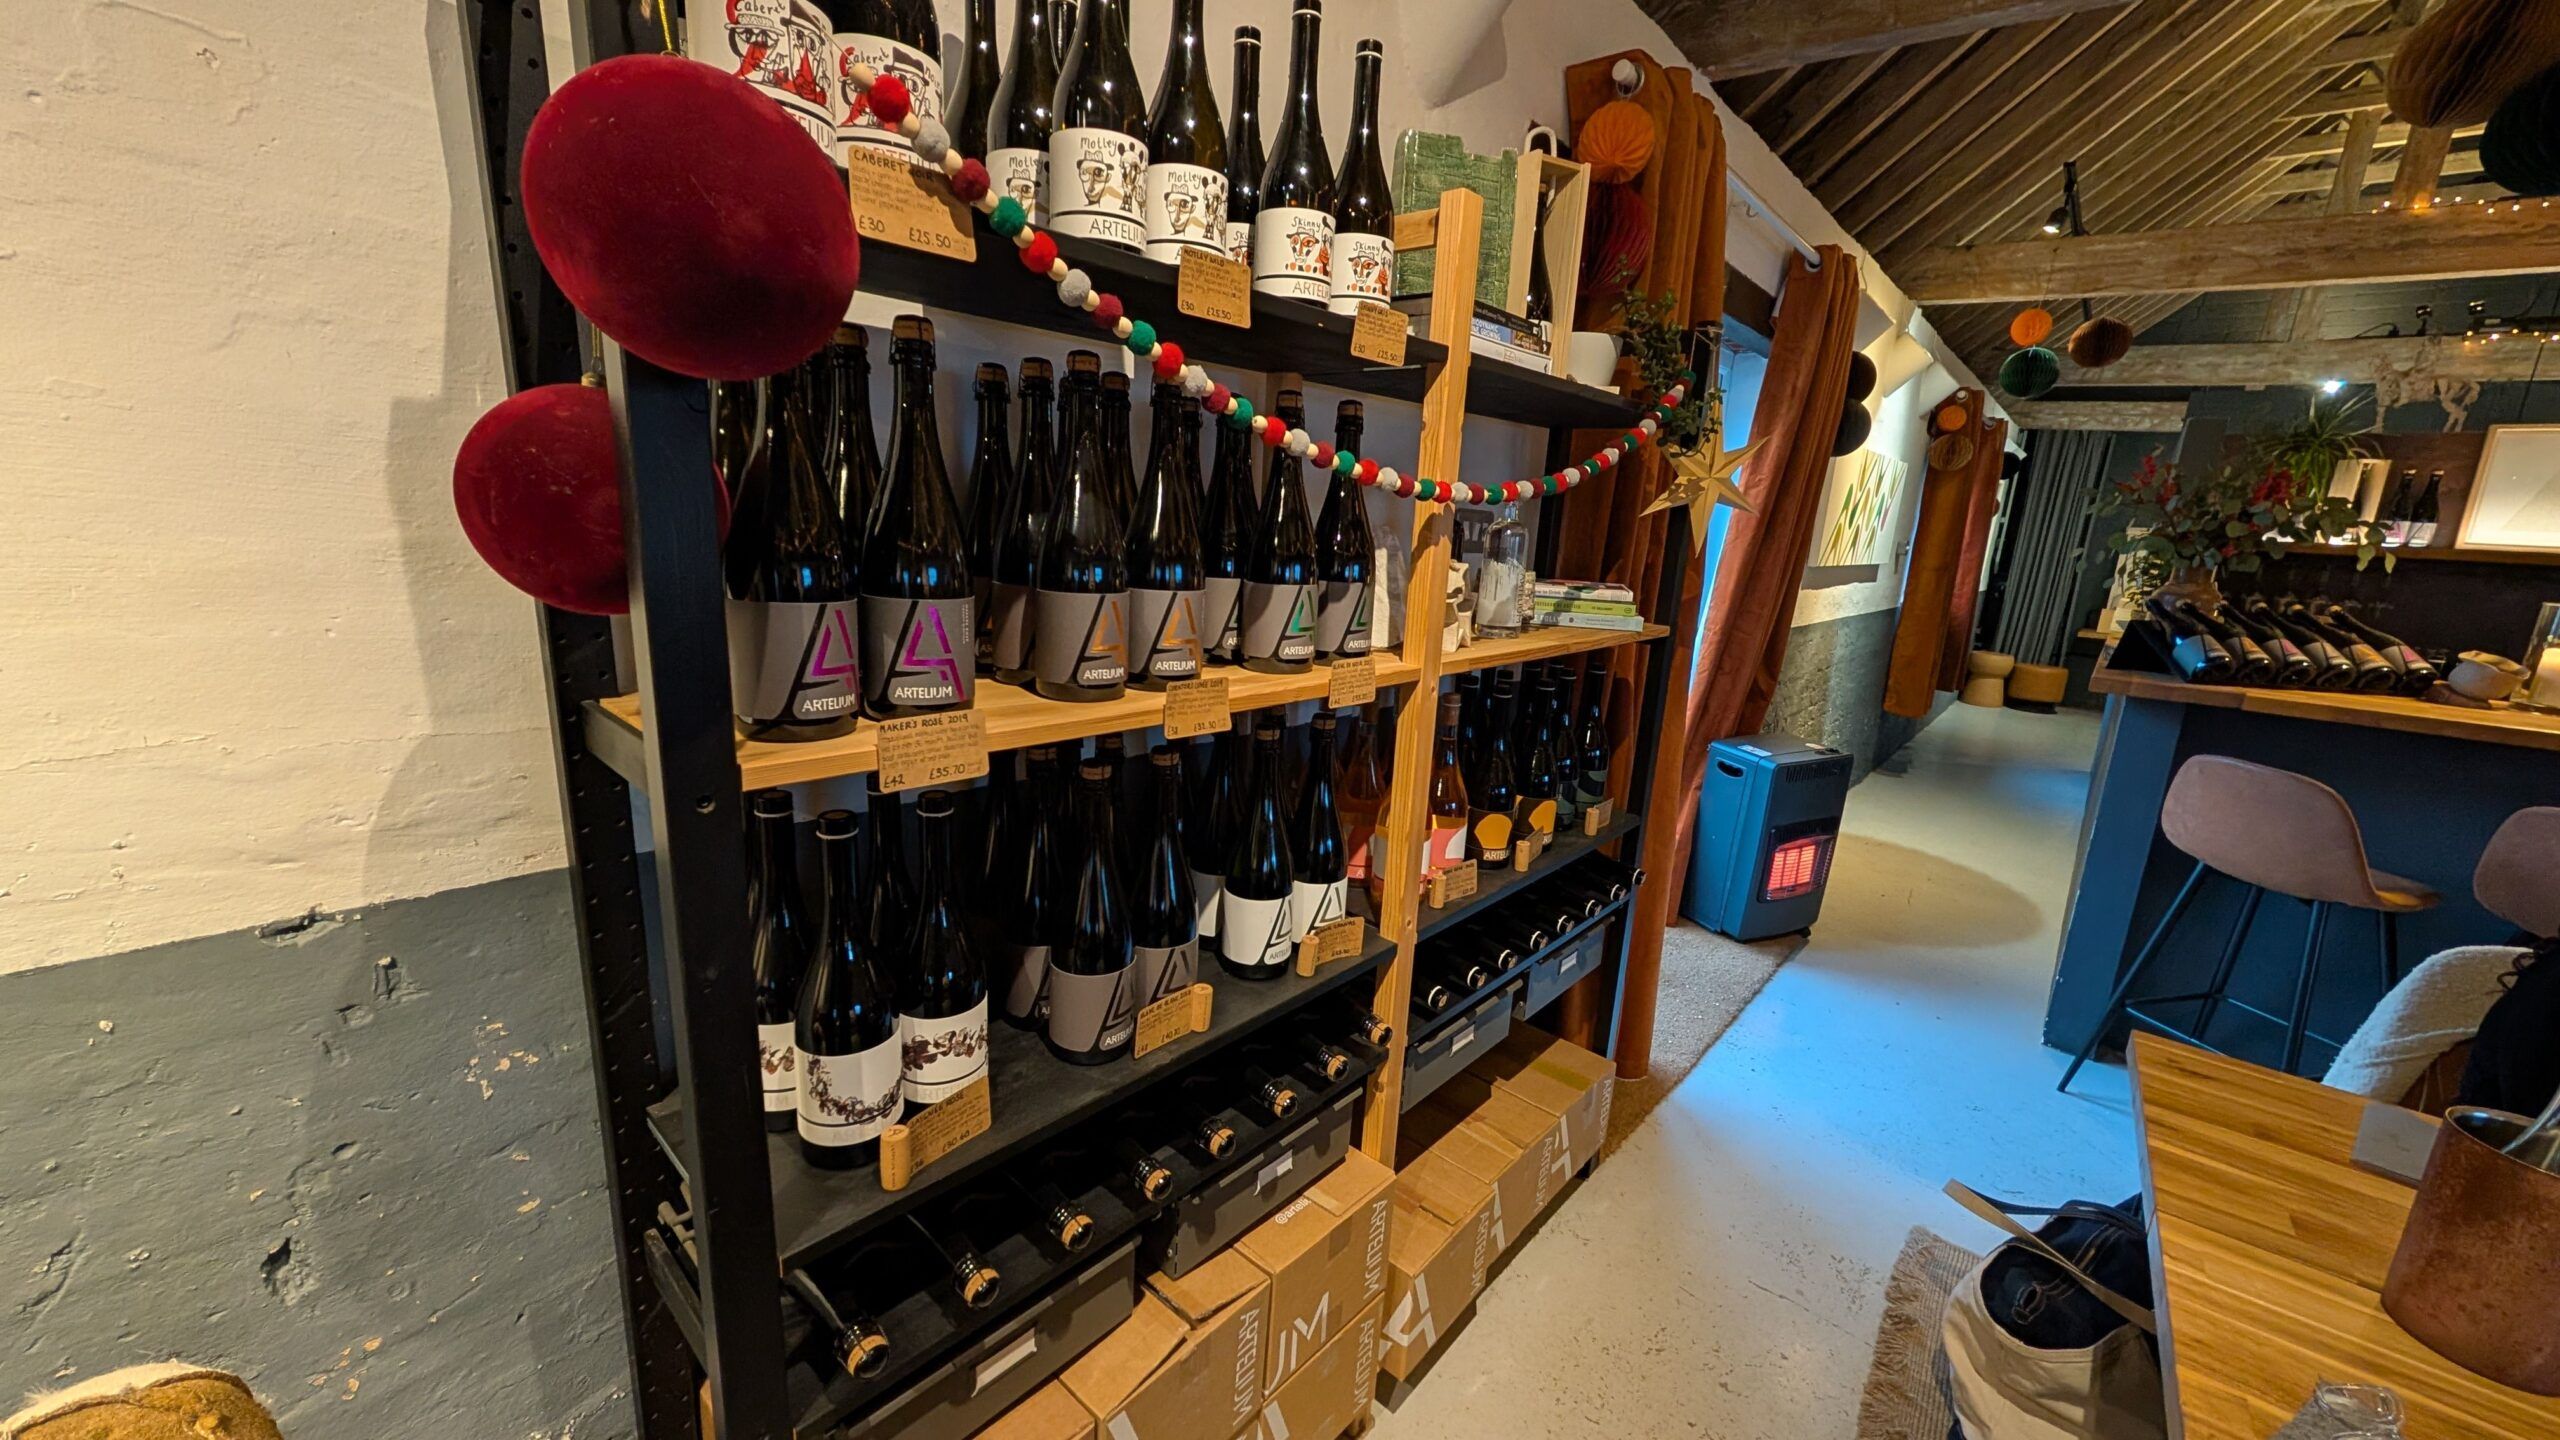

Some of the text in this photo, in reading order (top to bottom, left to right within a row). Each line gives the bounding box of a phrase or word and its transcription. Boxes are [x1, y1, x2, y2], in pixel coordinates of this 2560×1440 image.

[1080, 136, 1118, 157] Motley
[854, 149, 906, 175] CABERET
[1009, 156, 1043, 170] Motley
[1168, 171, 1202, 190] Motley
[858, 214, 886, 233] £30
[909, 227, 951, 249] £25.50
[1089, 218, 1146, 246] ARTELIU
[1291, 216, 1321, 233] Skinny
[1353, 241, 1381, 257] Skinny
[1292, 281, 1330, 298] ARTELI
[1181, 300, 1195, 311] £30
[1083, 667, 1125, 680] ARTELIUM
[1155, 660, 1196, 671] ARTELIUM
[895, 686, 952, 699] ARTELIUM
[801, 693, 856, 713] ARTELIUM
[883, 763, 966, 789] £42 £35.70
[1363, 1199, 1388, 1300] ARTELIUM
[1470, 1211, 1490, 1296] ARTELIUM
[1233, 1308, 1260, 1426] ARTELIUM
[1353, 1318, 1375, 1414] ARTELIUM
